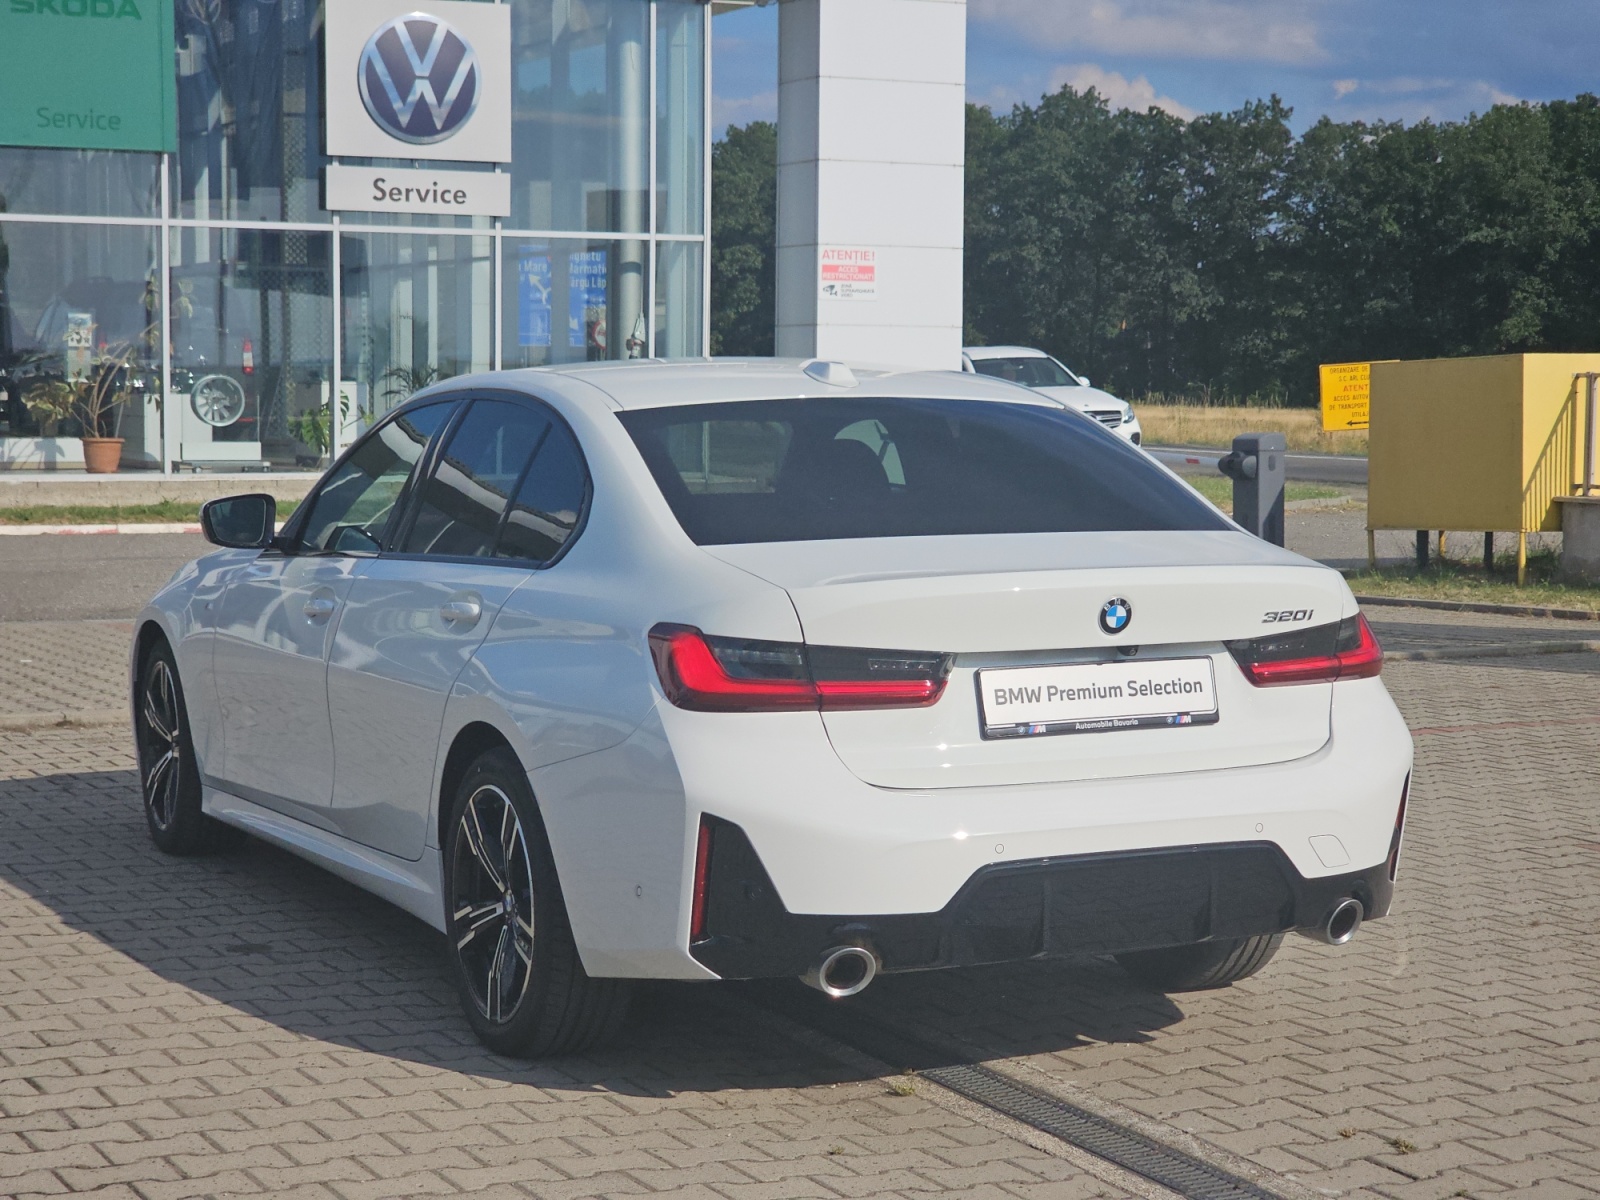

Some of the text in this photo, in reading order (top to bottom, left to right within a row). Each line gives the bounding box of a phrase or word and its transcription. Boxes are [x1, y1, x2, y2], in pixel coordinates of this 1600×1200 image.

[36, 107, 121, 130] Service
[372, 177, 467, 205] Service
[1343, 384, 1369, 392] ATENT
[1352, 393, 1369, 401] AUTOV
[1338, 402, 1367, 410] TRANSPORT
[1261, 609, 1314, 623] 320i
[994, 677, 1203, 706] BMW Premium Selection
[1075, 718, 1139, 730] Automobile Bavaria
